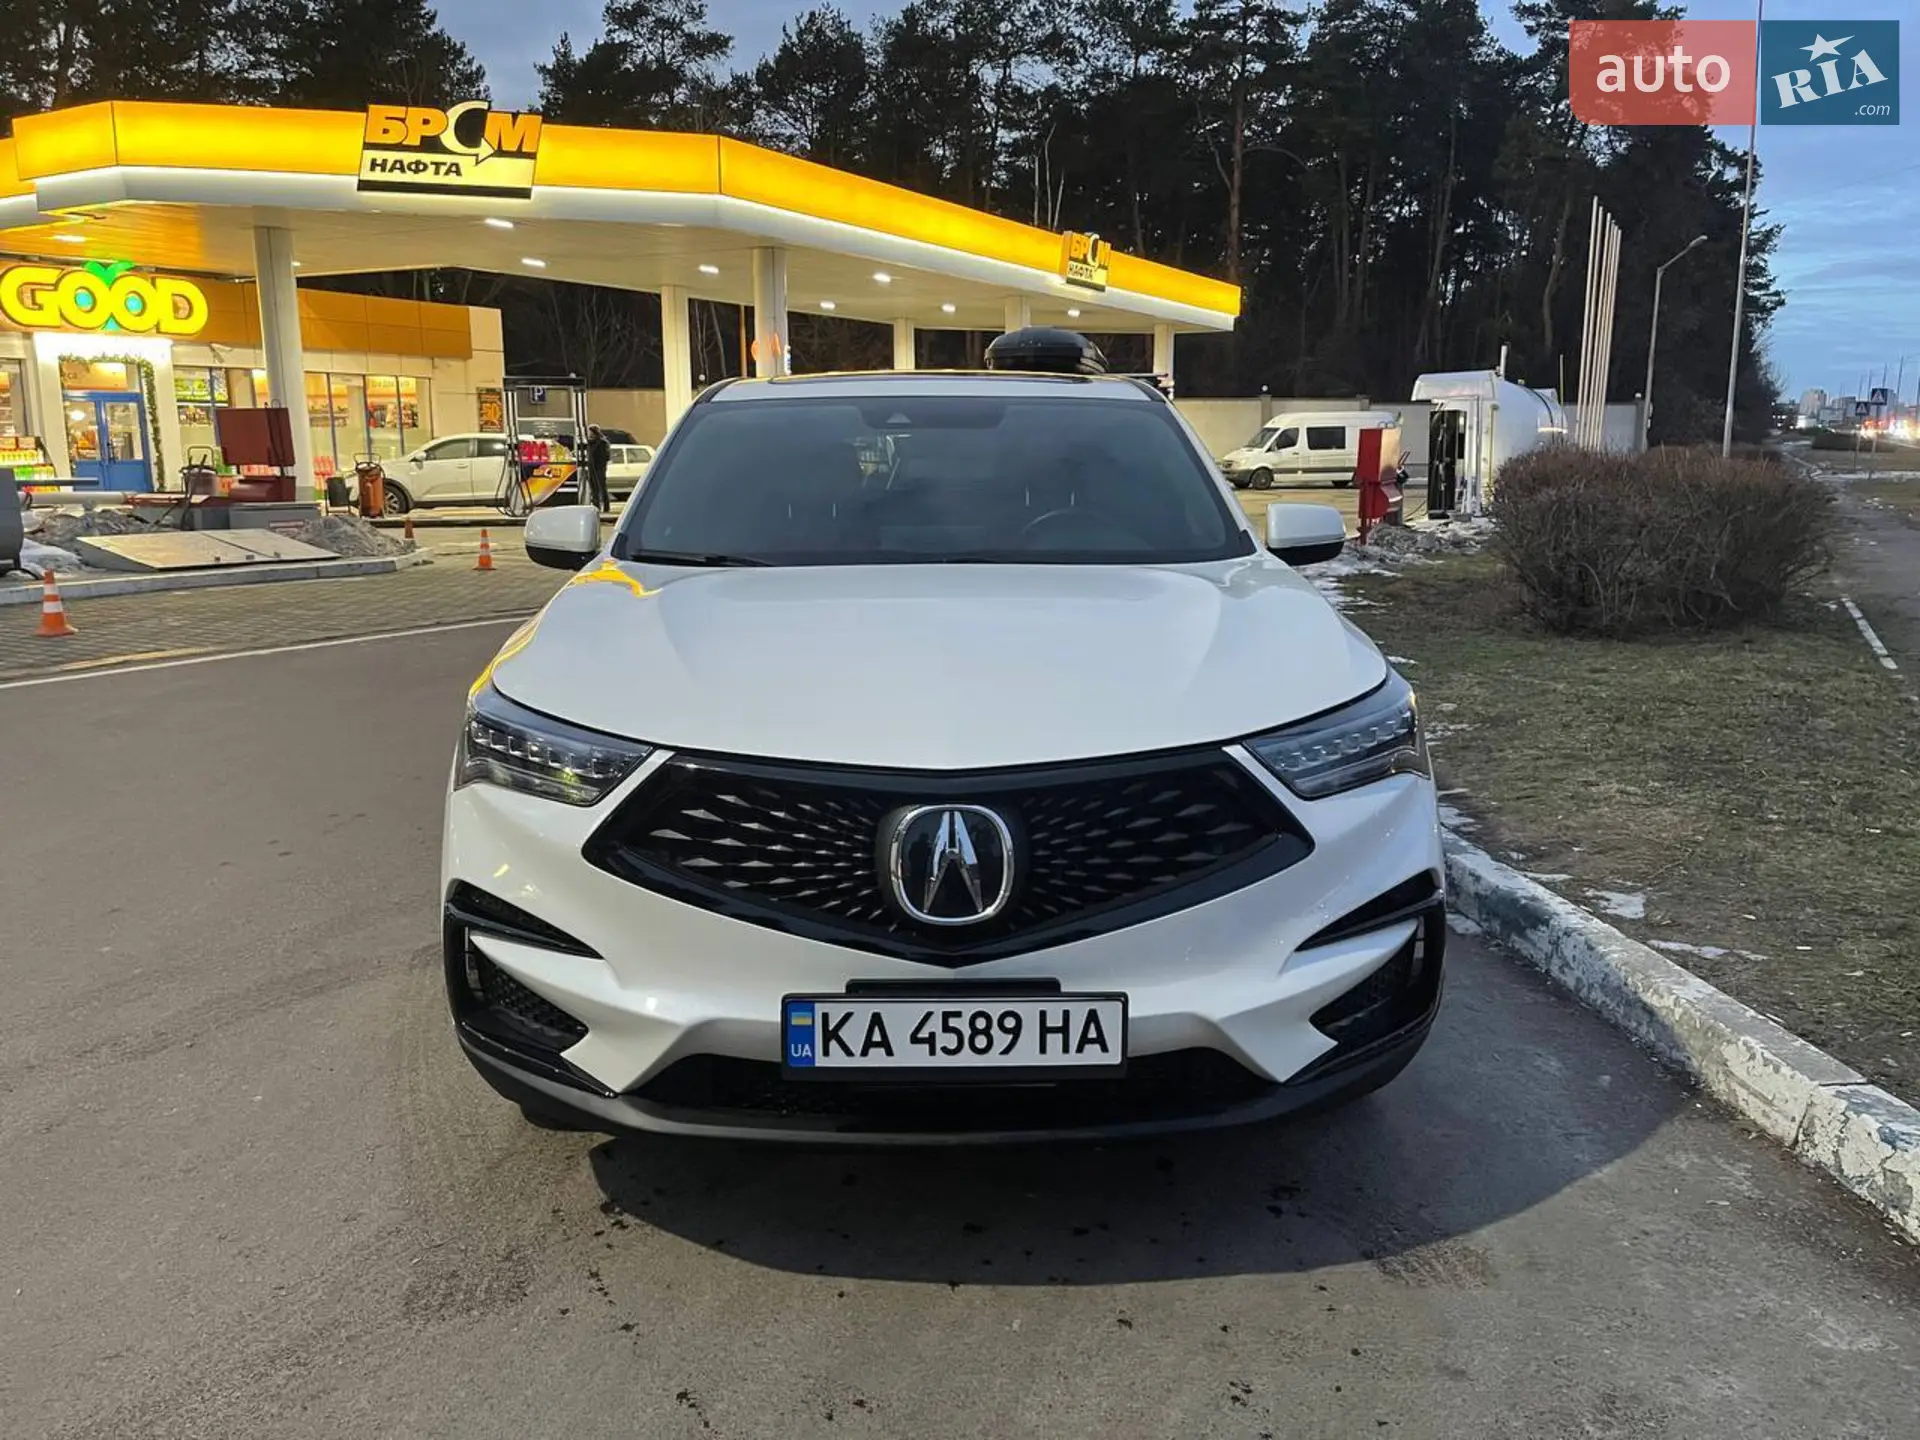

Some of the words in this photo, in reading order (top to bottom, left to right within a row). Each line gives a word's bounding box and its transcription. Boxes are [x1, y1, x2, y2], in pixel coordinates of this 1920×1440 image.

[365, 101, 542, 163] БРСМ
[369, 158, 462, 177] НАФТА
[0, 266, 209, 335] GOOD
[791, 1043, 812, 1058] UA
[821, 1010, 895, 1058] KA
[909, 1009, 1023, 1056] 4589
[1038, 1008, 1110, 1054] HA
